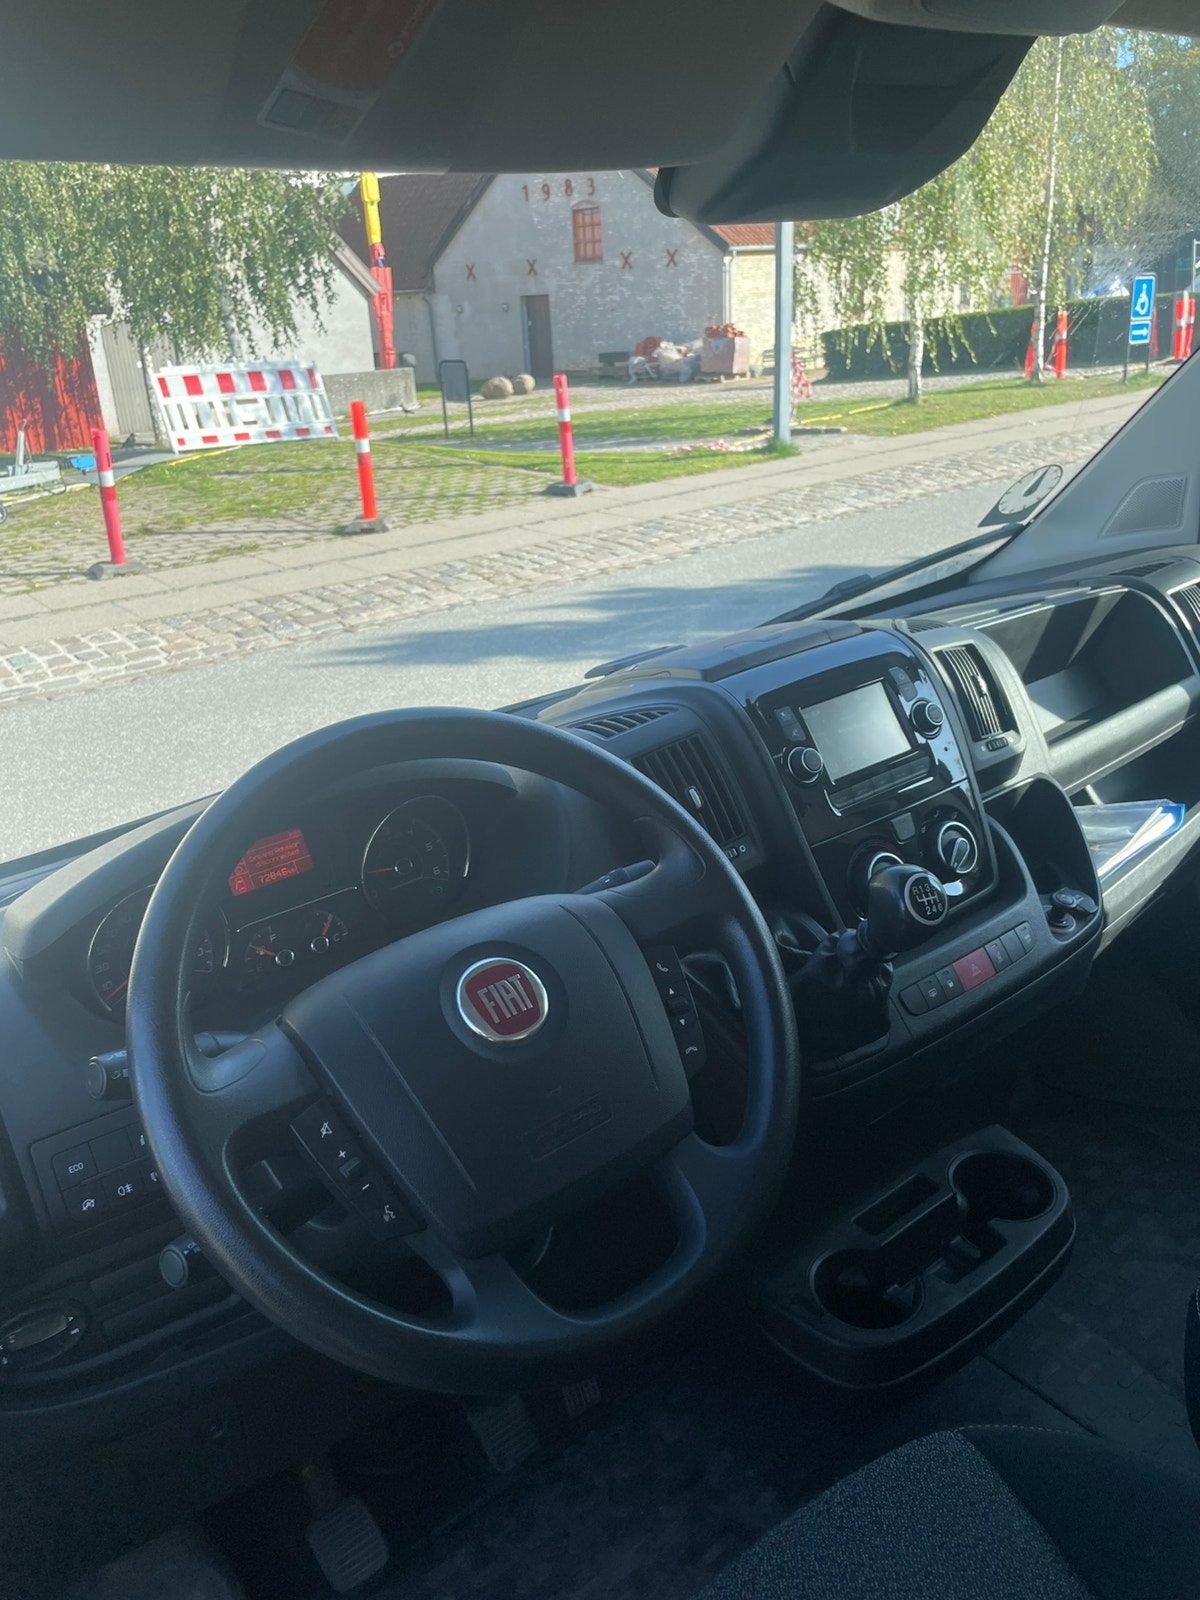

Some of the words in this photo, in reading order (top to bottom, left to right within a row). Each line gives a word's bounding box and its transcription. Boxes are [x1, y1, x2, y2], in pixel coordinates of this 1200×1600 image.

[521, 177, 595, 202] 1983
[258, 867, 288, 884] 72846
[477, 973, 534, 1024] FIAT
[68, 1162, 84, 1174] ECO
